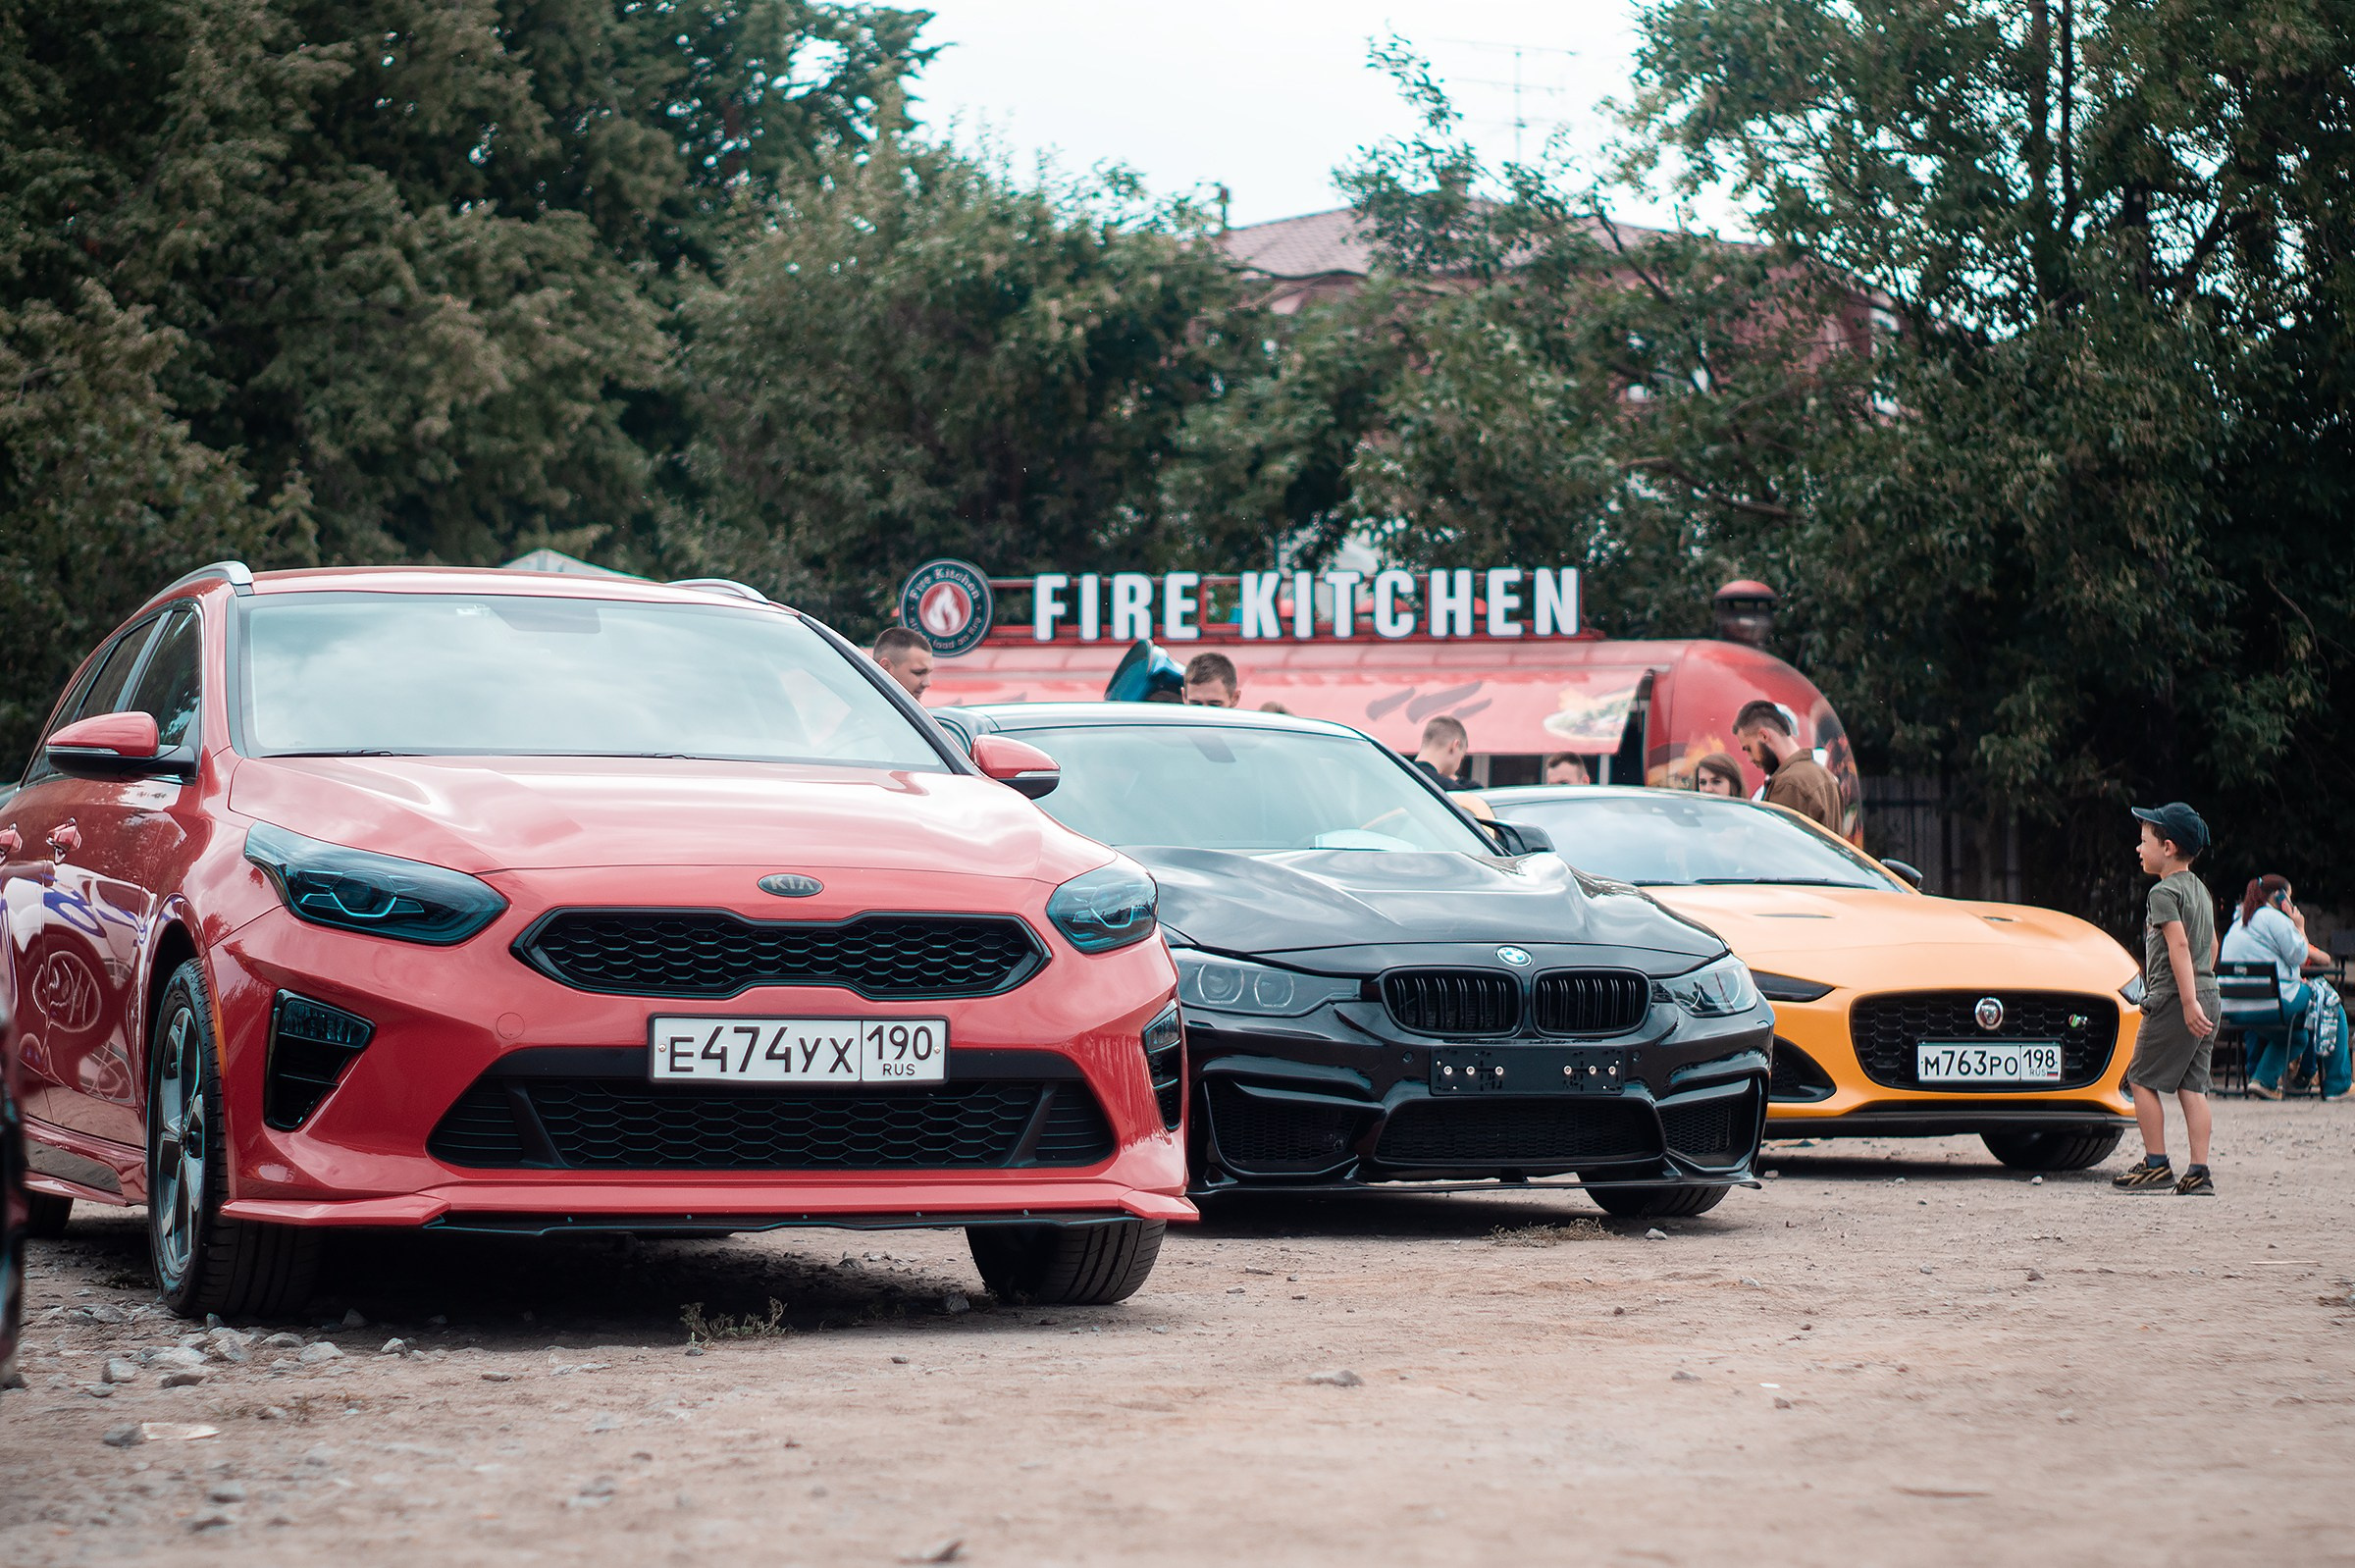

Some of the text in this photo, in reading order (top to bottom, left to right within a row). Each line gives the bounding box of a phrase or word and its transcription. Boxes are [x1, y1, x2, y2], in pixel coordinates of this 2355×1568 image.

[909, 568, 980, 601] Fire Kitchen
[1034, 567, 1581, 642] FIRE KITCHEN
[933, 640, 955, 650] food
[958, 635, 969, 646] on
[768, 875, 814, 891] KIA
[865, 1024, 933, 1061] 190
[2022, 1049, 2056, 1069] 198
[882, 1063, 916, 1076] RUS
[2029, 1069, 2047, 1077] RUS
